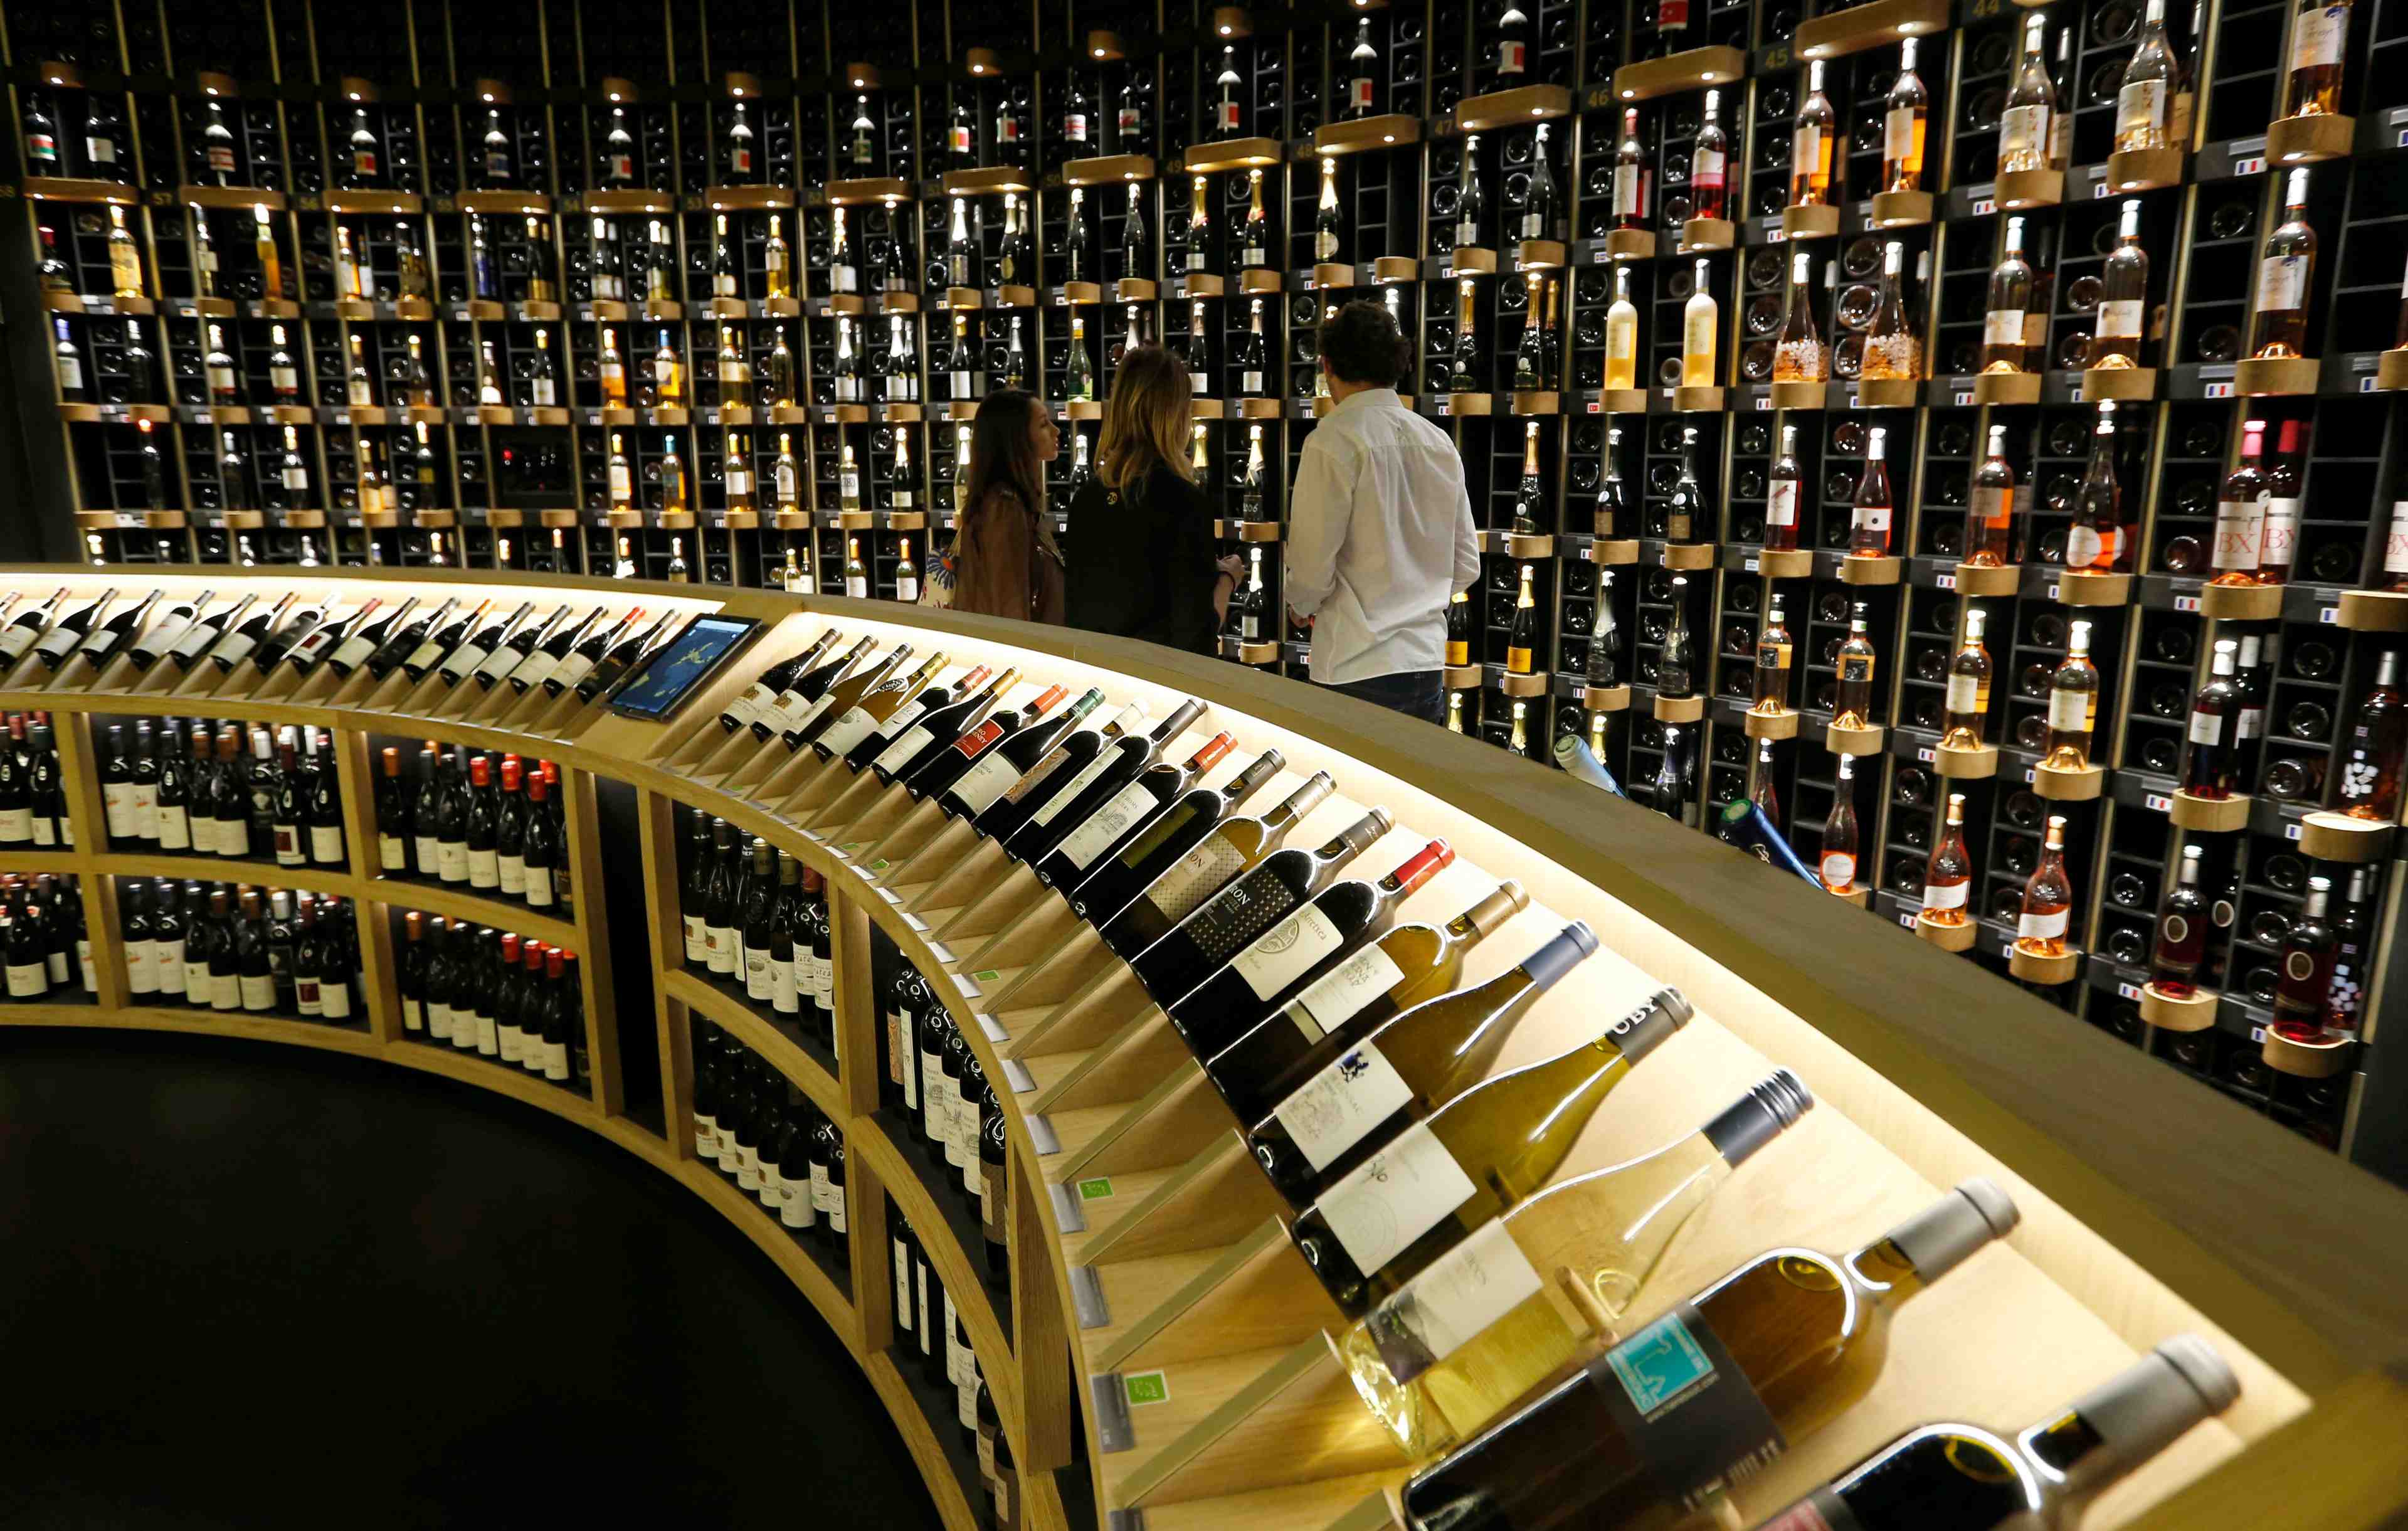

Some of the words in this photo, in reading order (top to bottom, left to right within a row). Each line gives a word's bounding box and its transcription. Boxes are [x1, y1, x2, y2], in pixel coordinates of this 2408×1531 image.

[1766, 48, 1787, 70] 45
[1588, 90, 1608, 107] 46
[1435, 119, 1454, 135] 47
[1297, 143, 1314, 159] 48
[1167, 159, 1182, 173] 49
[2218, 532, 2258, 553] BX
[1614, 997, 1658, 1034] UBY
